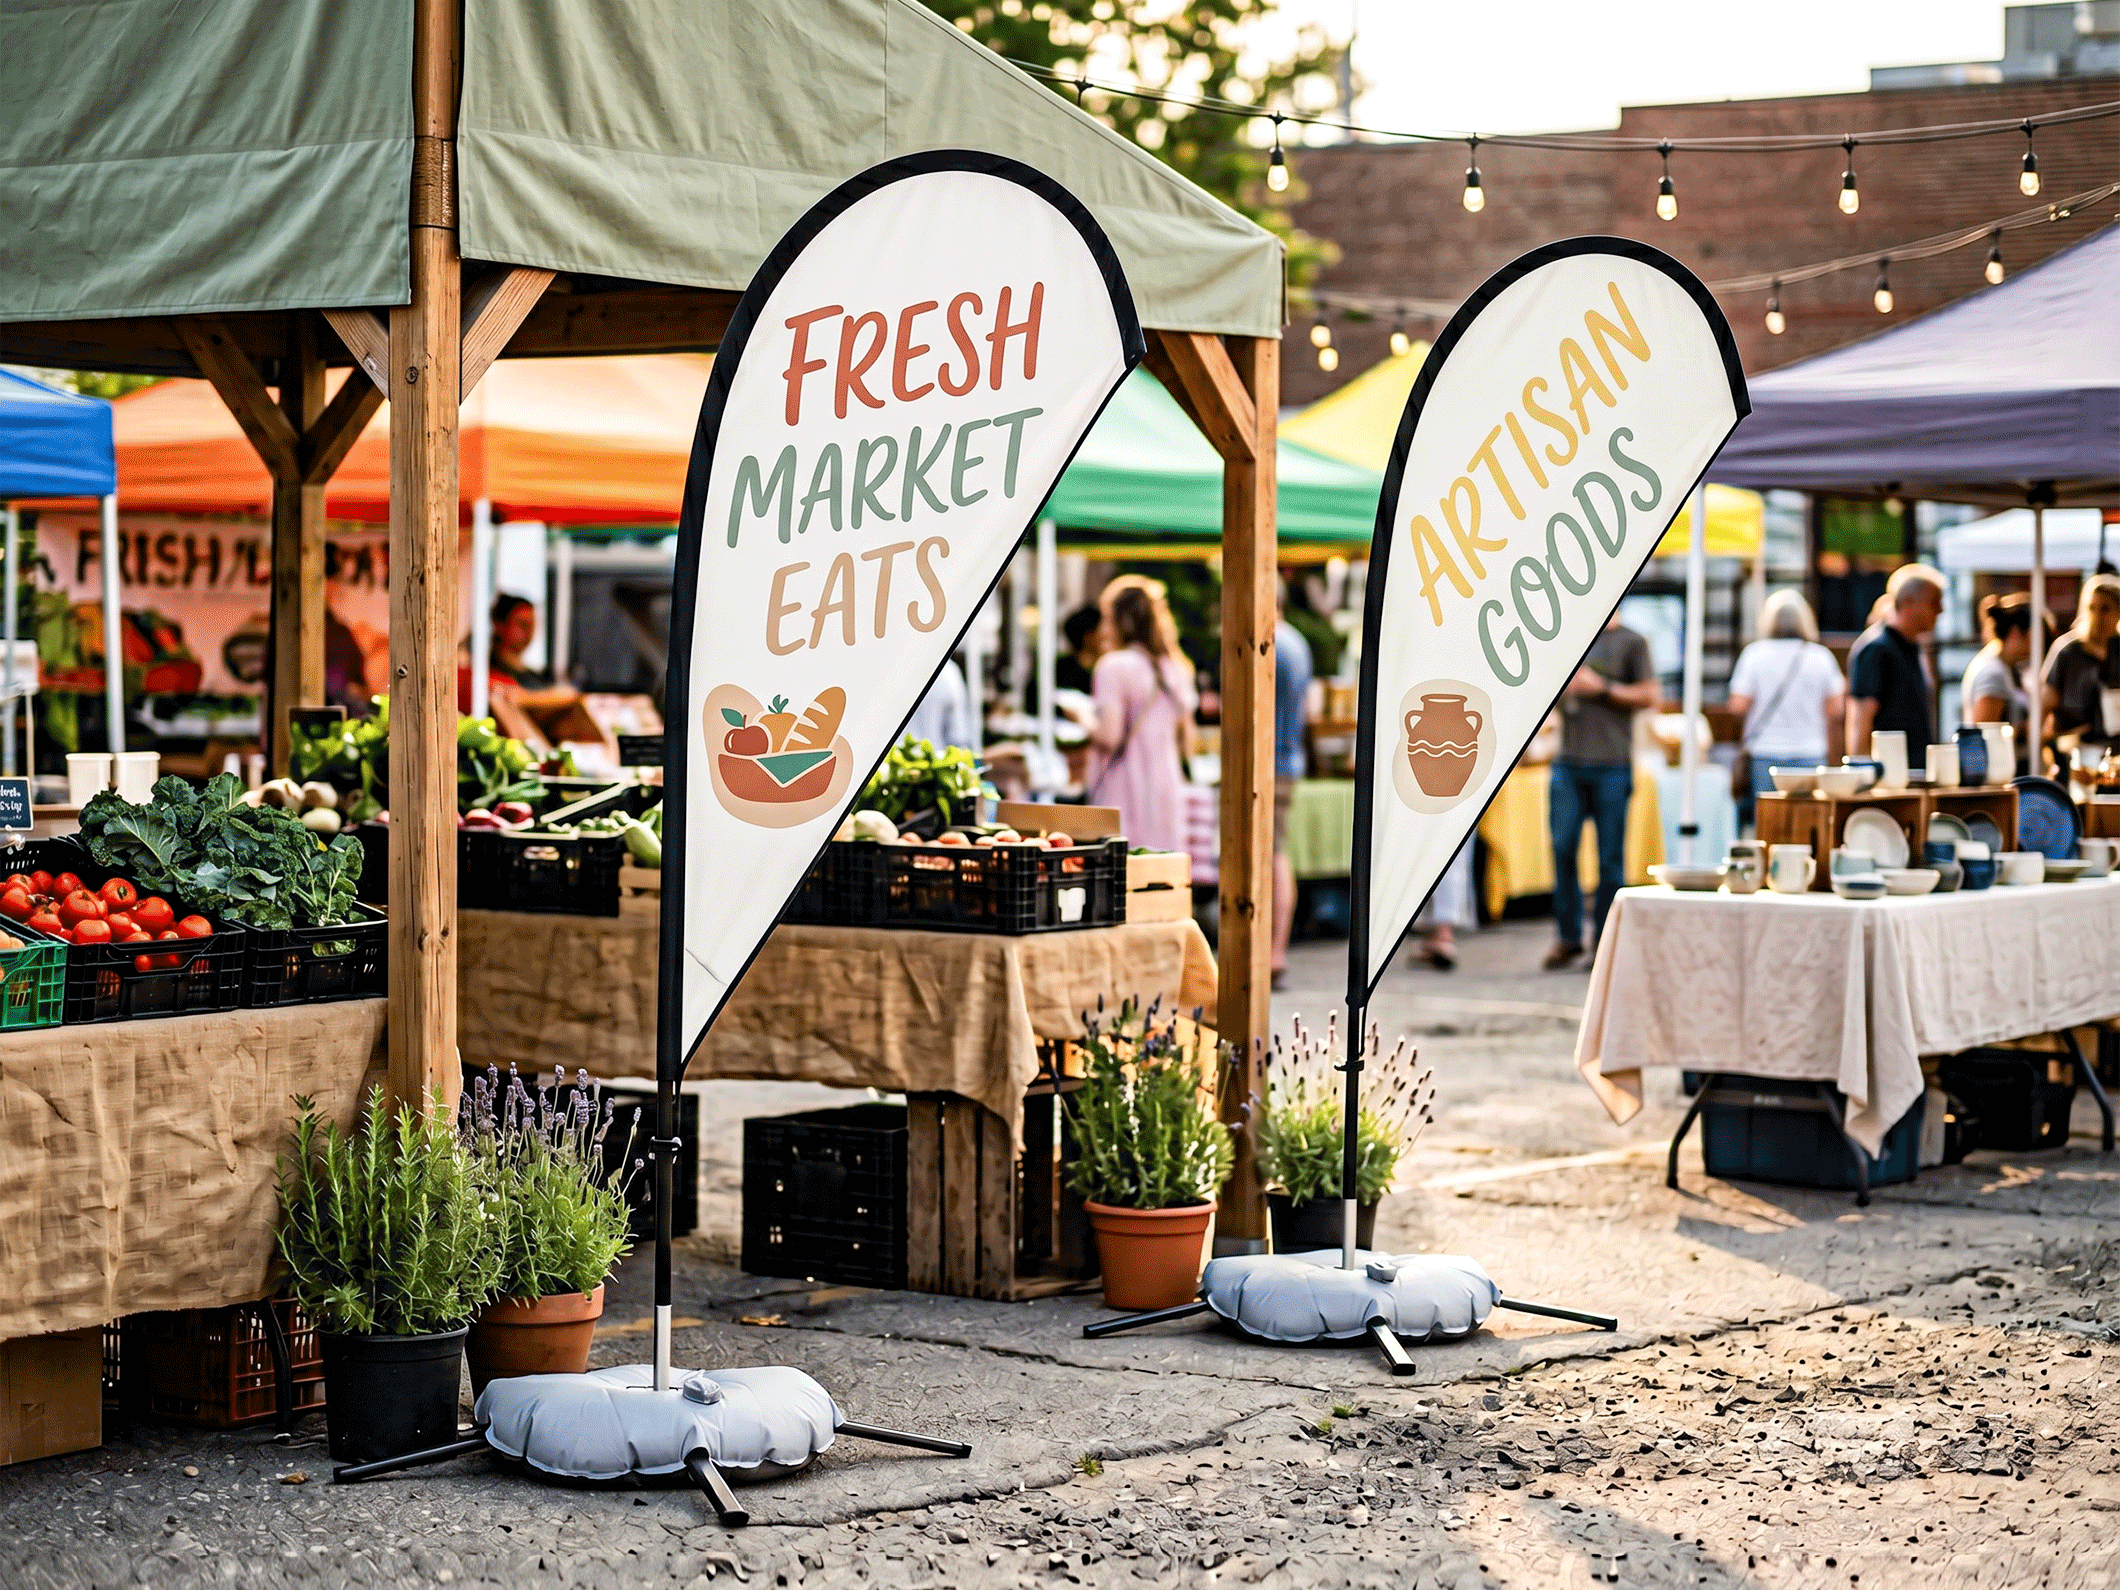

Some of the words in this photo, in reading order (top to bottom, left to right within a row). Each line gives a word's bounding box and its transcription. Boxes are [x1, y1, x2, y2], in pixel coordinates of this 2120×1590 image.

[782, 281, 1045, 427] FRESH
[727, 407, 1045, 549] MARKET
[1410, 281, 1652, 627] ARTISAN
[765, 535, 951, 657] EATS
[1477, 426, 1662, 687] GOODS
